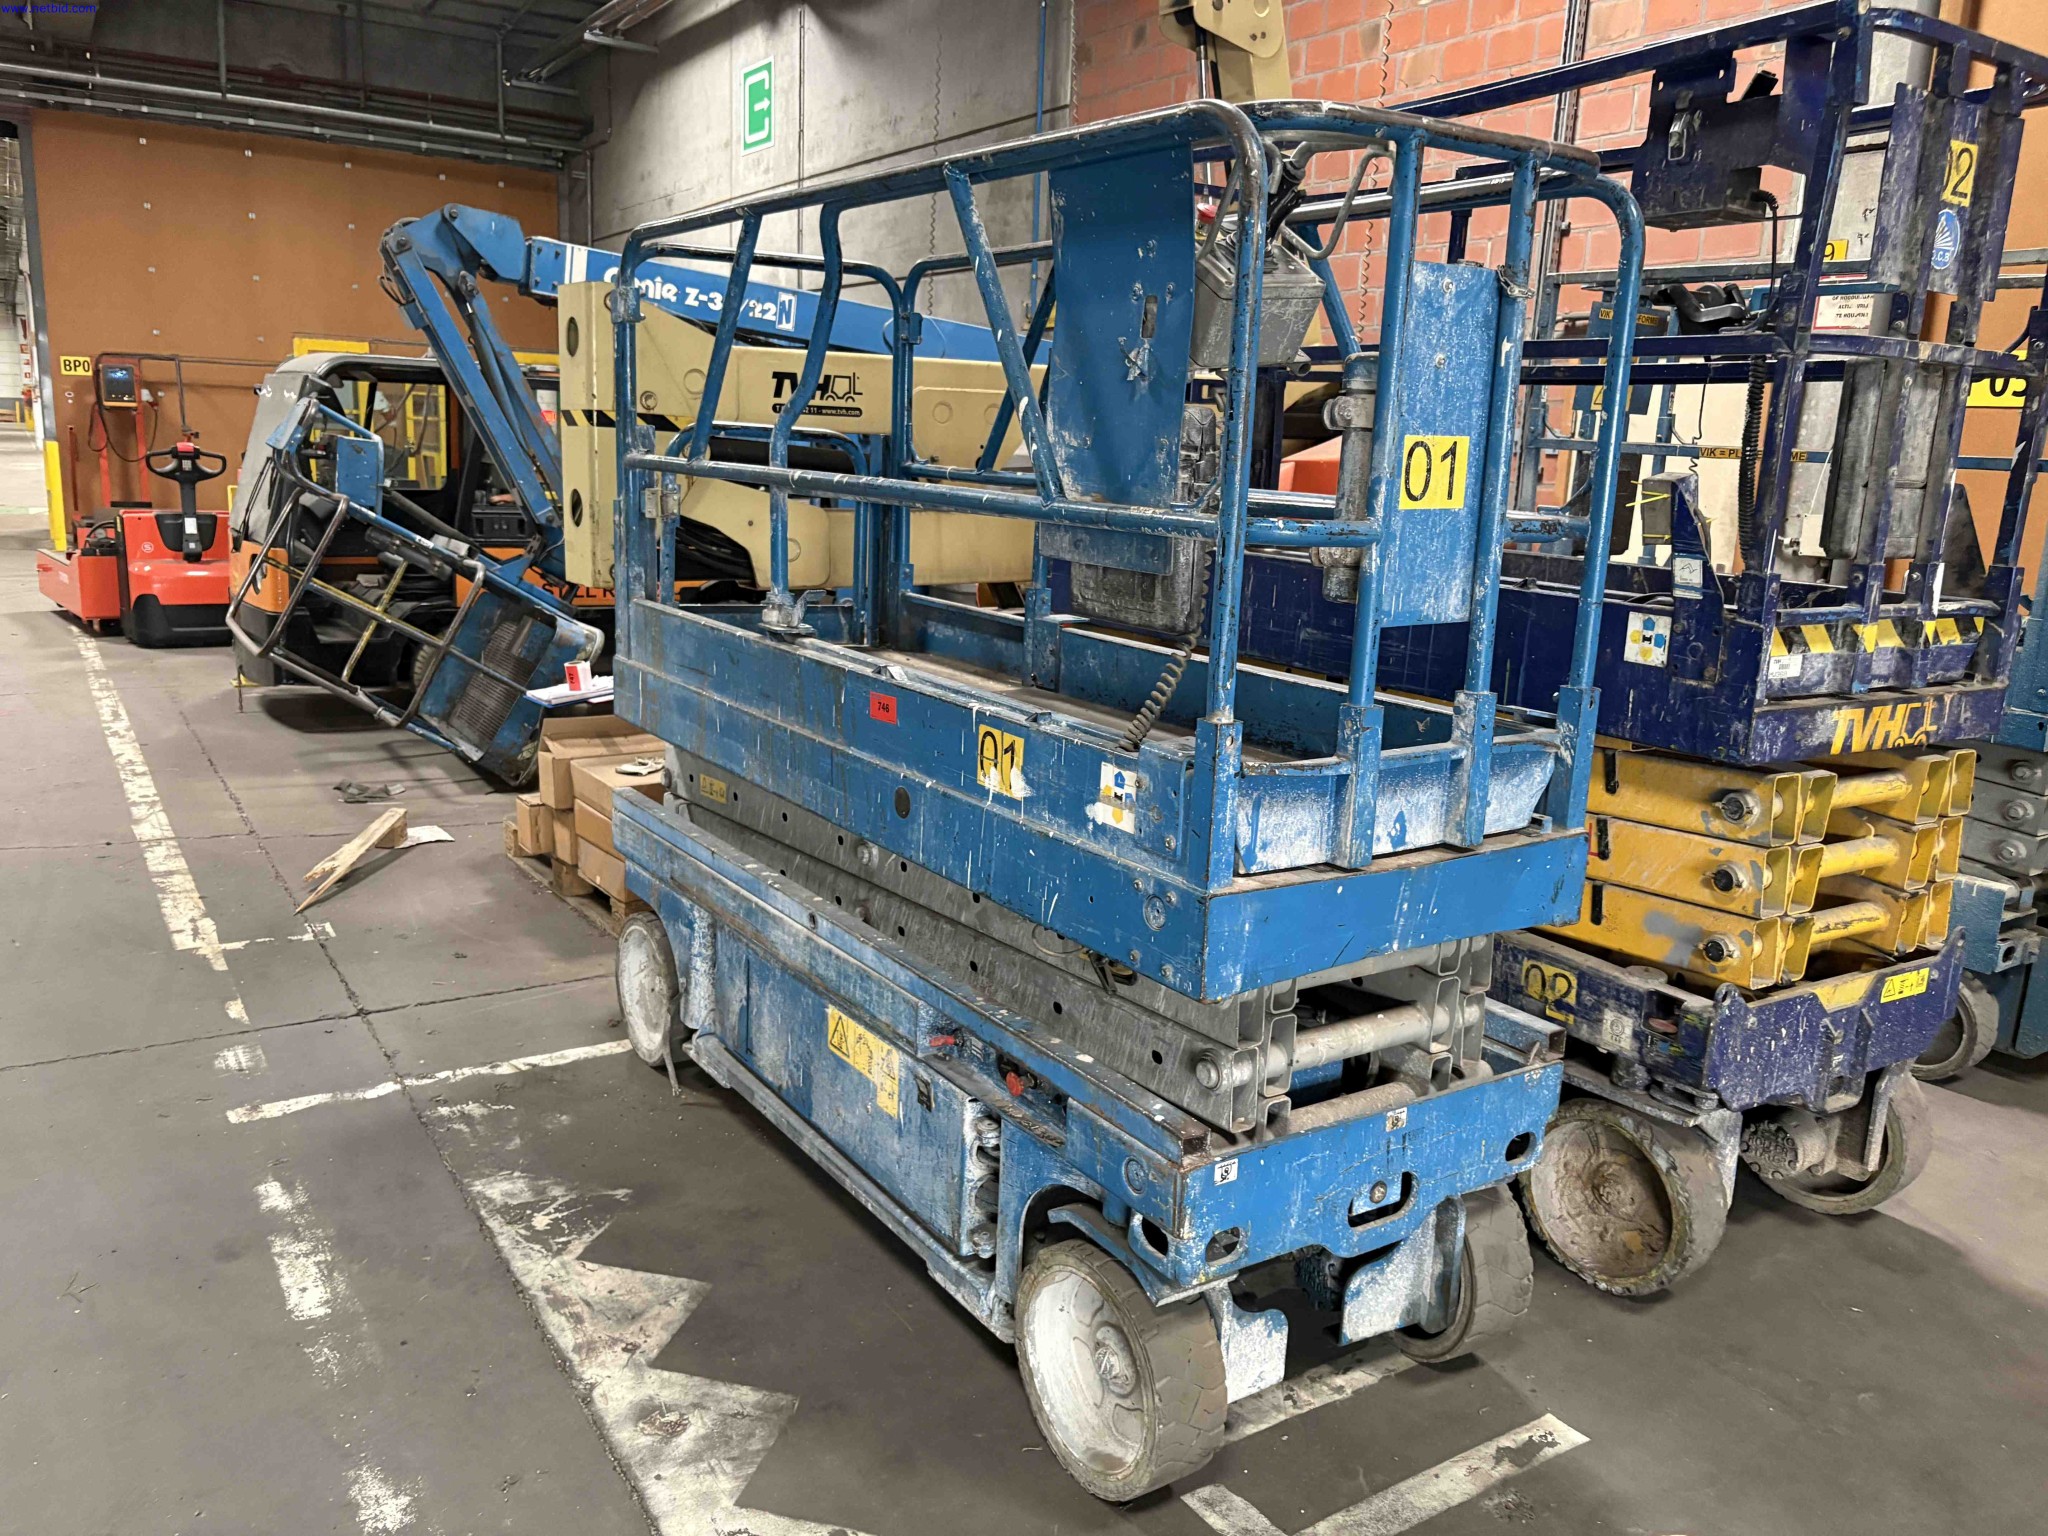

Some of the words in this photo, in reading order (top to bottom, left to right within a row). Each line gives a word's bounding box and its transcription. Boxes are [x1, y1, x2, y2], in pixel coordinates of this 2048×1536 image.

[821, 408, 860, 416] www.tvh.com
[1700, 448, 1717, 457] VIK
[1404, 440, 1458, 502] 01
[877, 701, 890, 714] 746
[1830, 703, 1908, 755] TVH
